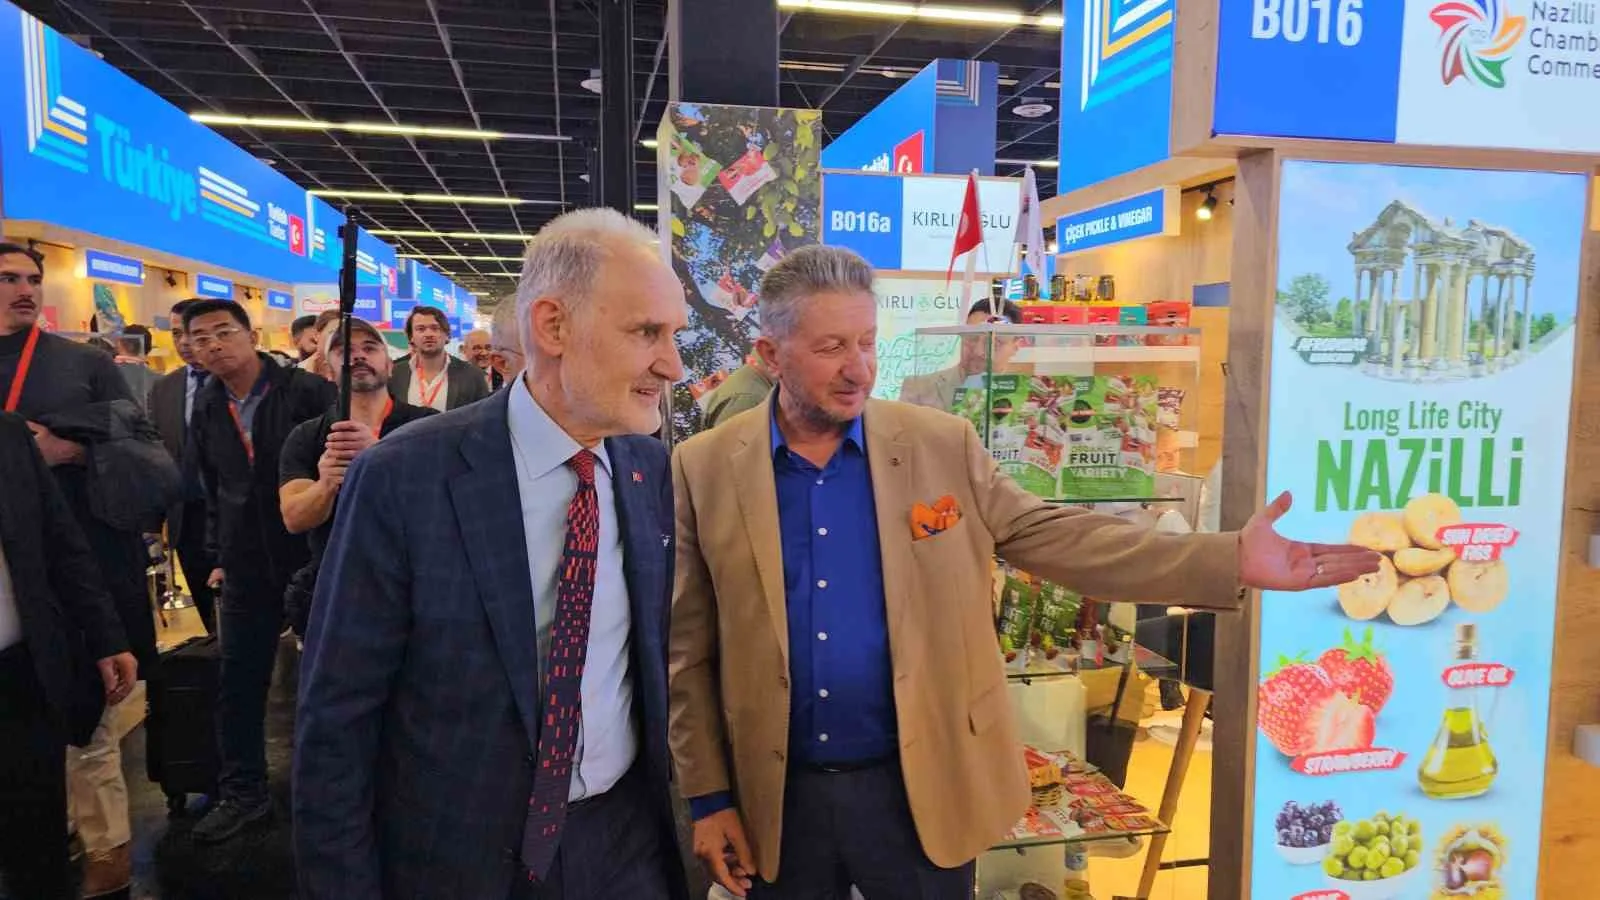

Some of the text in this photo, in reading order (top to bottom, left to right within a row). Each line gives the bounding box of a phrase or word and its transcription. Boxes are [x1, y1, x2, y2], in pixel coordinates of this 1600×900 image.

[1251, 0, 1363, 46] B016
[1532, 1, 1594, 25] Nazilli
[94, 112, 197, 221] Türkiye
[832, 211, 891, 233] B016a
[1085, 216, 1110, 237] PICKLE
[1110, 215, 1118, 231] &
[1117, 206, 1153, 229] VINEGAR
[1343, 400, 1503, 436] Long Life City
[1069, 453, 1117, 464] FRUIT
[1070, 467, 1129, 478] VARIETY
[1303, 750, 1397, 774] STRAWBERRY
